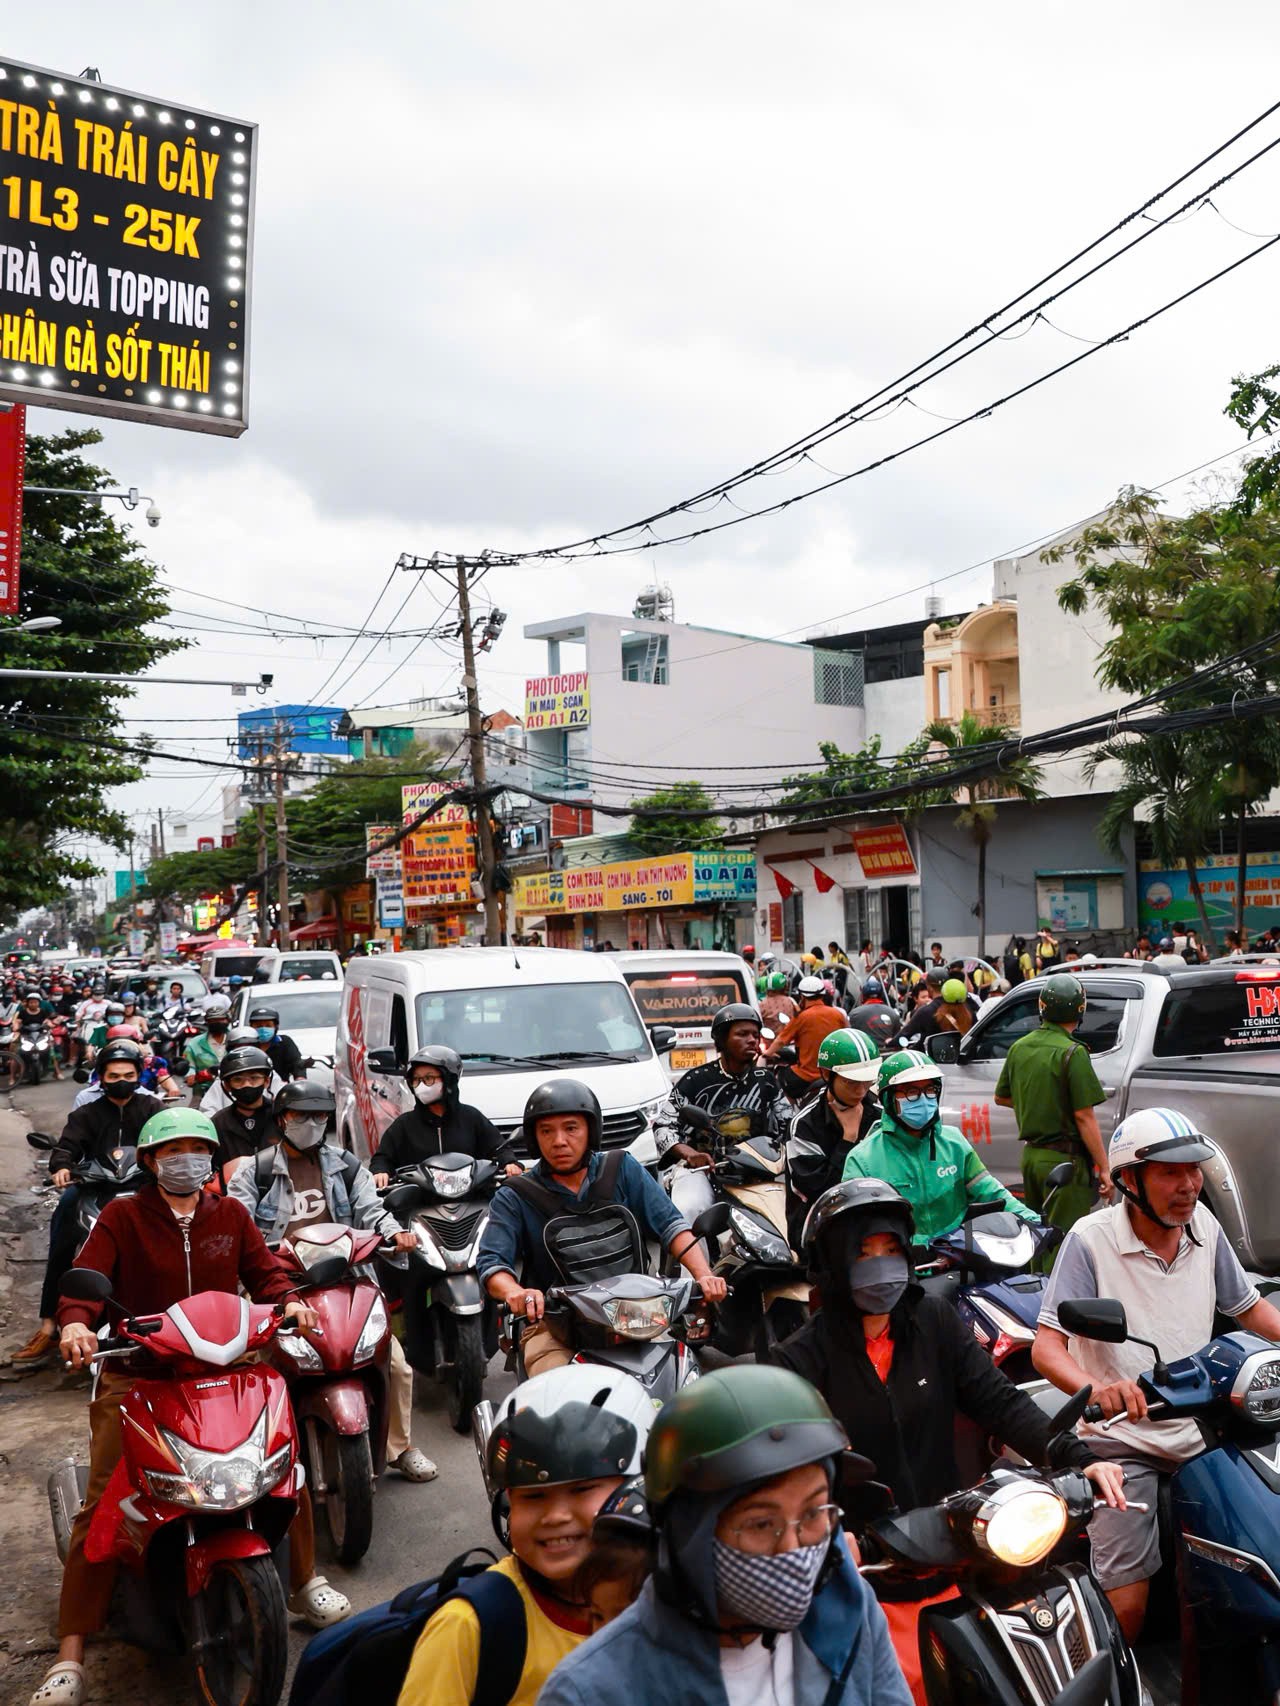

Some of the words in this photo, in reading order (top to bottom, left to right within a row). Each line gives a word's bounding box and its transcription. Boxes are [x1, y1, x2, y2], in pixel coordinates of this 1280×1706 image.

[0, 99, 63, 166] TRÀ
[74, 120, 147, 185] TRÁI
[158, 137, 220, 200] CÂY
[2, 176, 79, 232] 1L3
[122, 203, 201, 259] 25K
[49, 252, 99, 308] SỮA
[108, 267, 209, 330] TOPPING
[0, 308, 57, 367] HÂN
[64, 319, 97, 375] GÀ
[105, 322, 151, 383] SỐT
[159, 339, 210, 393] THÁI
[526, 672, 589, 698] PHOTOCOPY
[530, 701, 537, 712] IN
[563, 695, 583, 708] SCAN
[549, 711, 564, 726] A1
[570, 709, 588, 723] A2
[447, 807, 464, 821] A2
[719, 867, 738, 880] A1
[623, 892, 646, 905] SANG
[196, 1380, 229, 1389] HONDA
